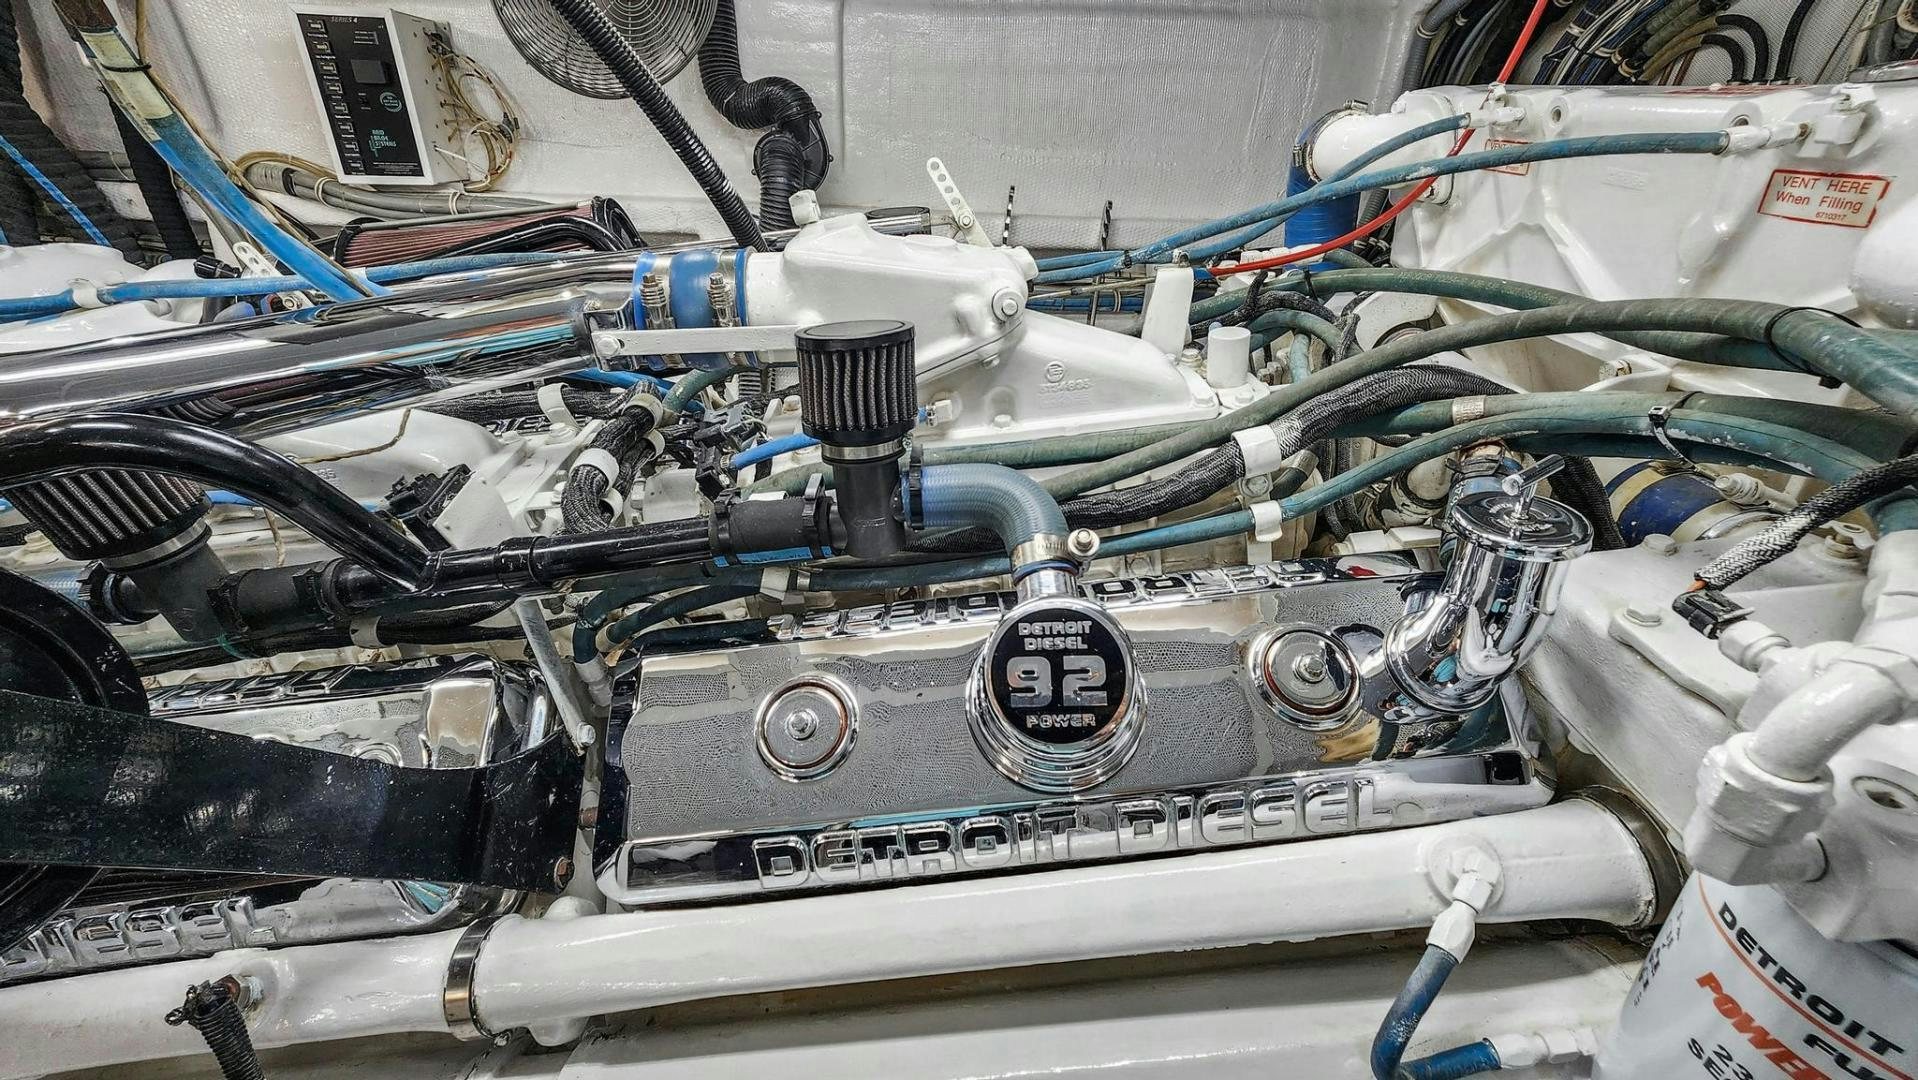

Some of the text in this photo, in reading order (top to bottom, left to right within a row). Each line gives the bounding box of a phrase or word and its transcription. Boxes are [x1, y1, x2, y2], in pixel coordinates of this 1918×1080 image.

[1783, 176, 1872, 195] VENT HERE
[1776, 191, 1864, 214] When Filling
[1018, 621, 1092, 636] DETROIT
[1024, 636, 1088, 651] DIESEL
[1006, 655, 1108, 708] 92
[1026, 713, 1096, 729] POWER
[752, 778, 1393, 889] DETROIT DIESEL
[1717, 901, 1905, 1056] DETROIT
[1687, 1037, 1730, 1080] SE
[1802, 1033, 1886, 1080] FU
